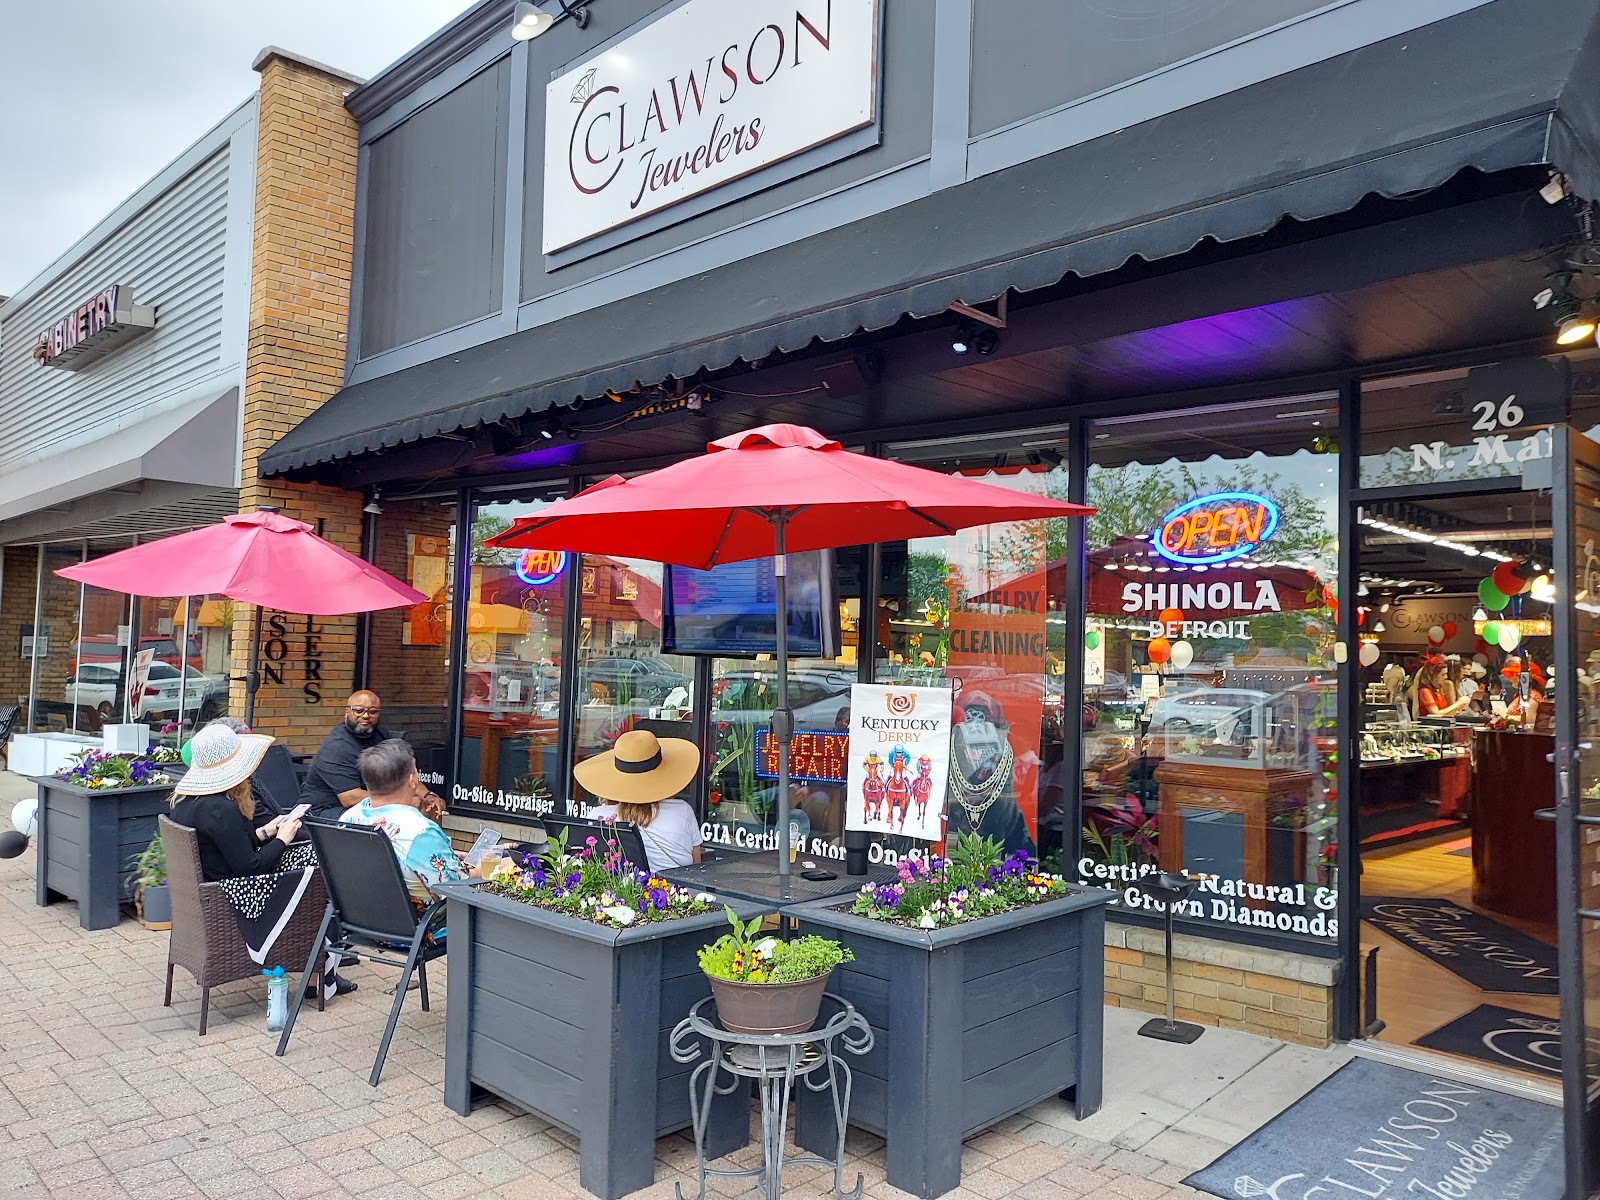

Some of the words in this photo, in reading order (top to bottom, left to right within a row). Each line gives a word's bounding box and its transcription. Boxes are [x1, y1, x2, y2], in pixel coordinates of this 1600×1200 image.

[585, 0, 831, 165] CLAWSON
[630, 113, 766, 209] Jewelers
[1471, 394, 1524, 431] 26
[1409, 440, 1455, 472] N.
[1162, 504, 1265, 552] OPEN
[520, 549, 561, 574] OPEN
[954, 589, 1040, 615] JEWELRY
[1122, 579, 1281, 612] SHINOLA
[950, 629, 1044, 657] CLEANING
[1149, 620, 1250, 639] DETROIT
[861, 716, 939, 731] KENTUCKY
[877, 731, 921, 744] DERBY
[768, 754, 842, 779] RPAIR
[452, 783, 494, 804] On-Site
[495, 789, 555, 814] Appraiser
[566, 799, 579, 818] We
[700, 822, 731, 846] GIA
[736, 826, 806, 853] Certifd
[1197, 872, 1306, 906] Natural
[1313, 886, 1338, 910] &
[1211, 898, 1338, 937] Diamonds
